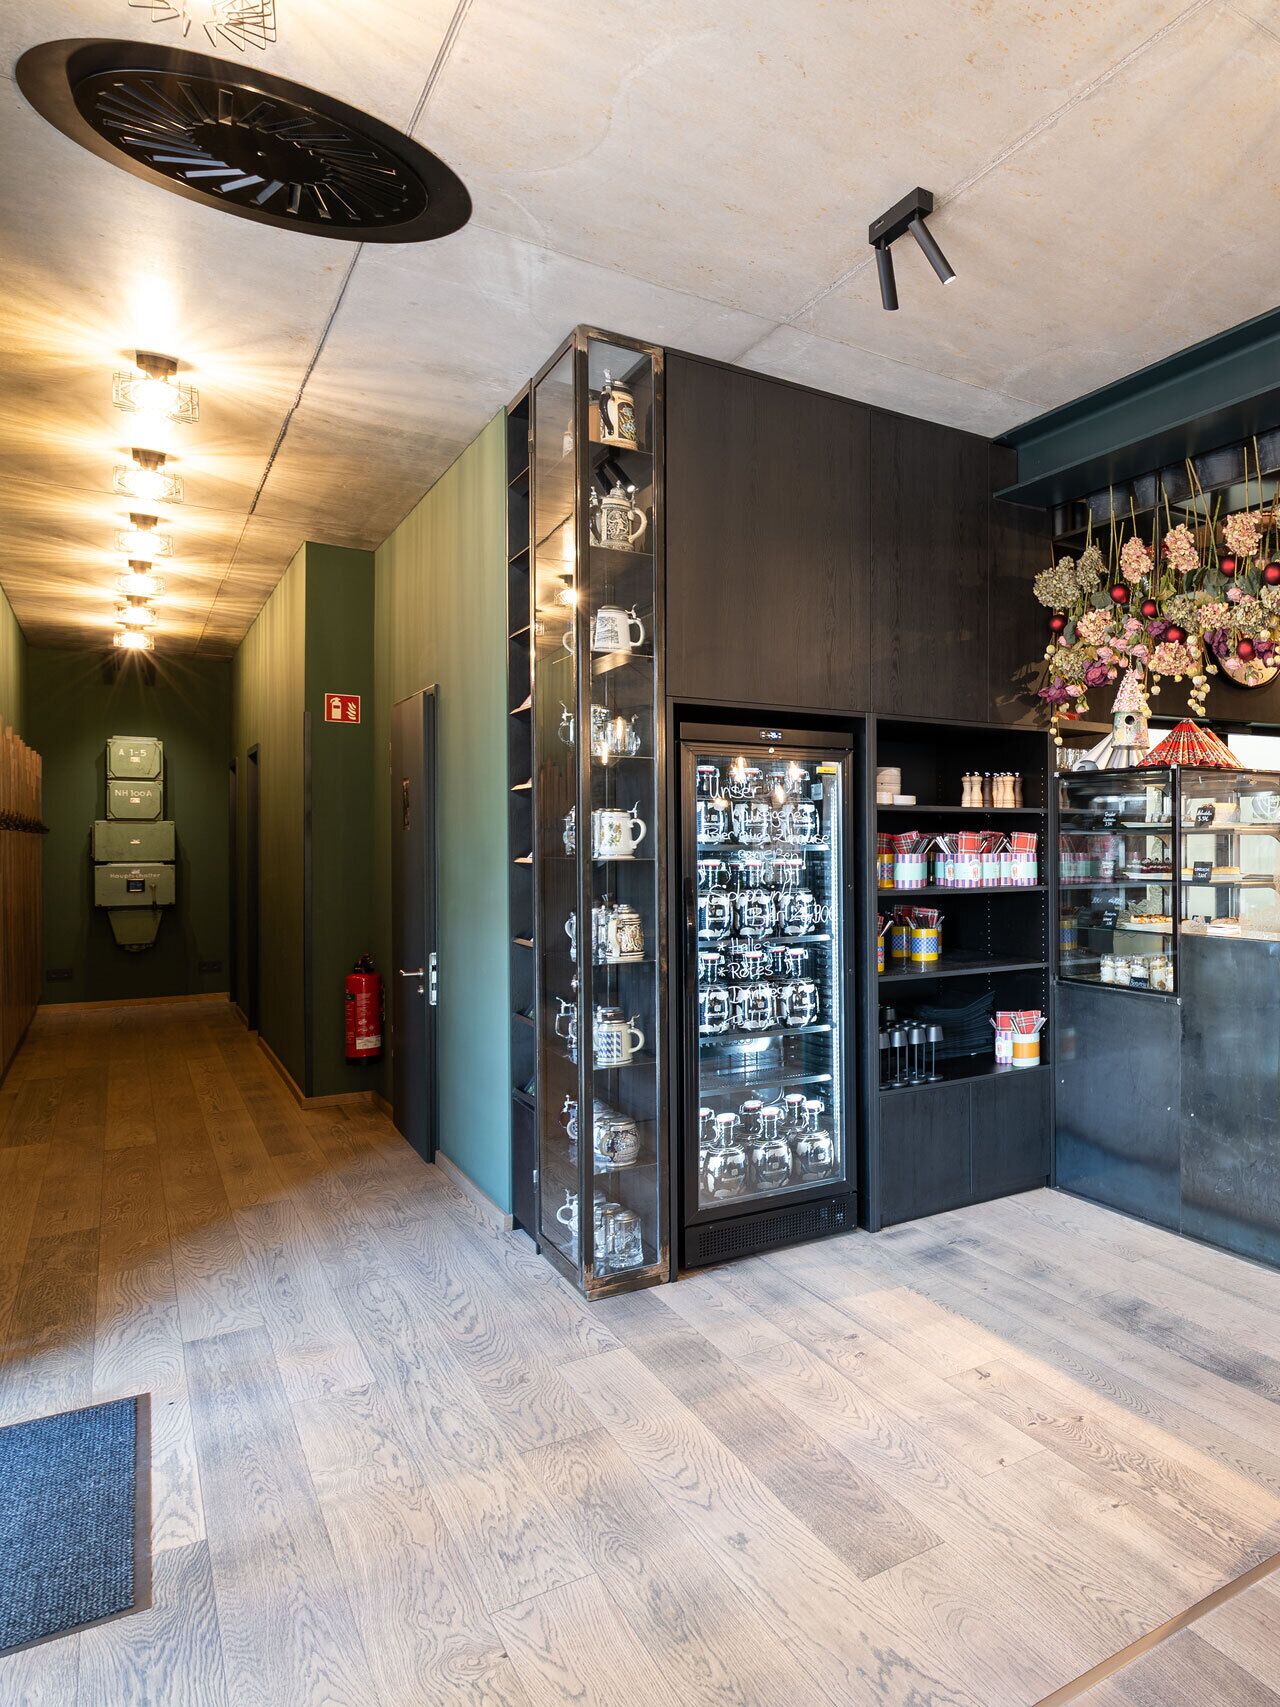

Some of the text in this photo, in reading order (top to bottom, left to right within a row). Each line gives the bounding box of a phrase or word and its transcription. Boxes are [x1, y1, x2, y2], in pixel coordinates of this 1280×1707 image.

[129, 749, 147, 757] 1-5
[114, 789, 129, 797] NH
[729, 937, 770, 956] Helles
[727, 962, 774, 980] Rotes
